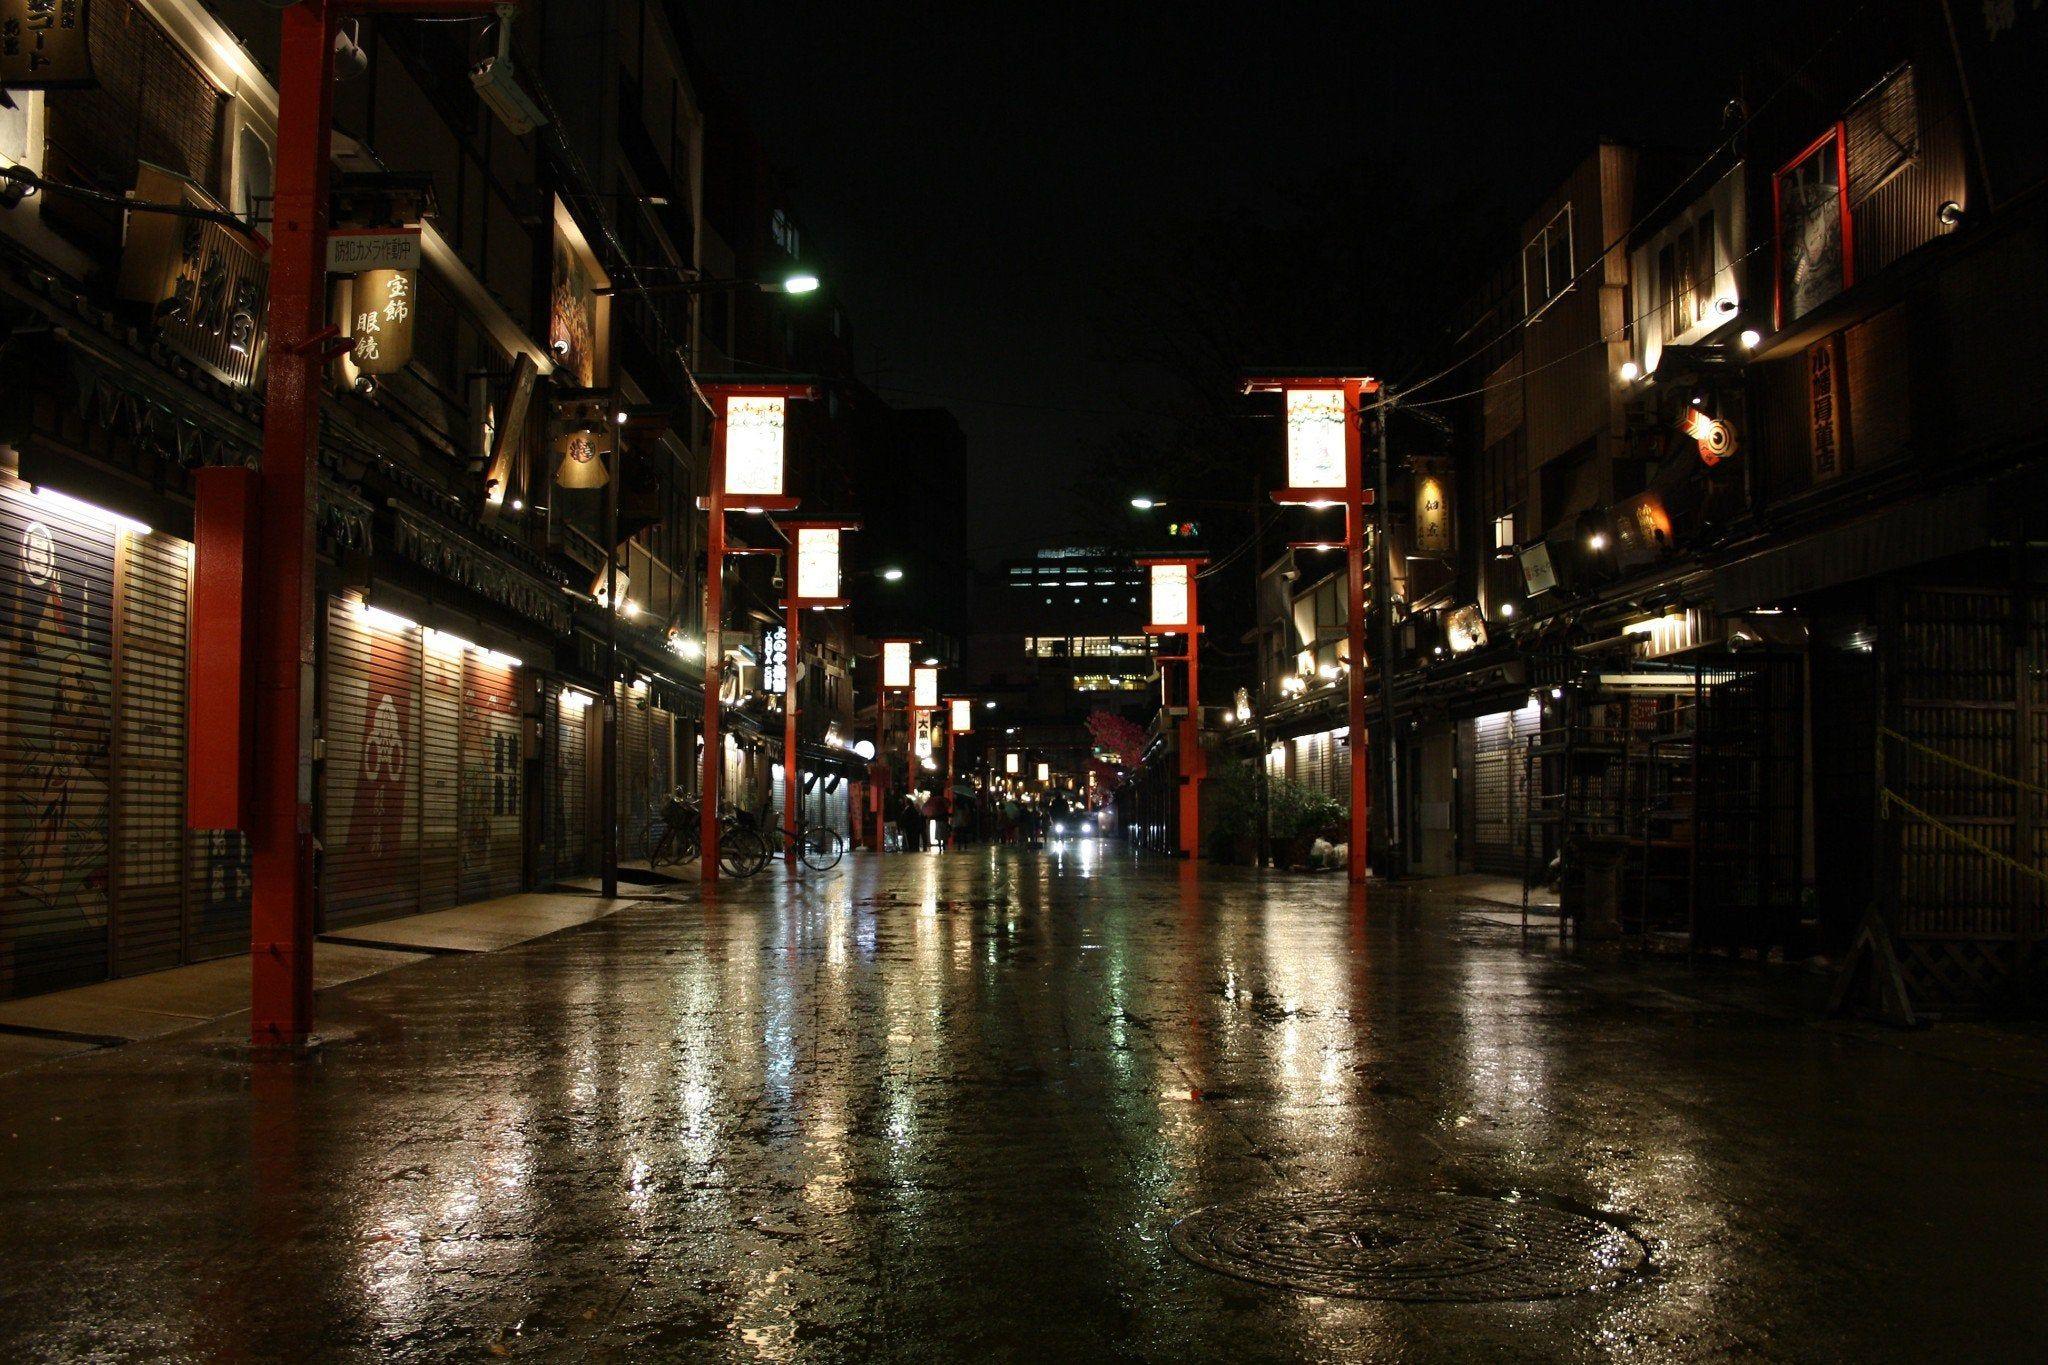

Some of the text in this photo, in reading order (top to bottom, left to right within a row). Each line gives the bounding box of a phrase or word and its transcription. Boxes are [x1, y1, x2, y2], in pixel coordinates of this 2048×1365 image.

[335, 239, 411, 264] 防犯カメラ作動中
[383, 274, 409, 324] 宝飾
[355, 310, 381, 360] 眼鏡
